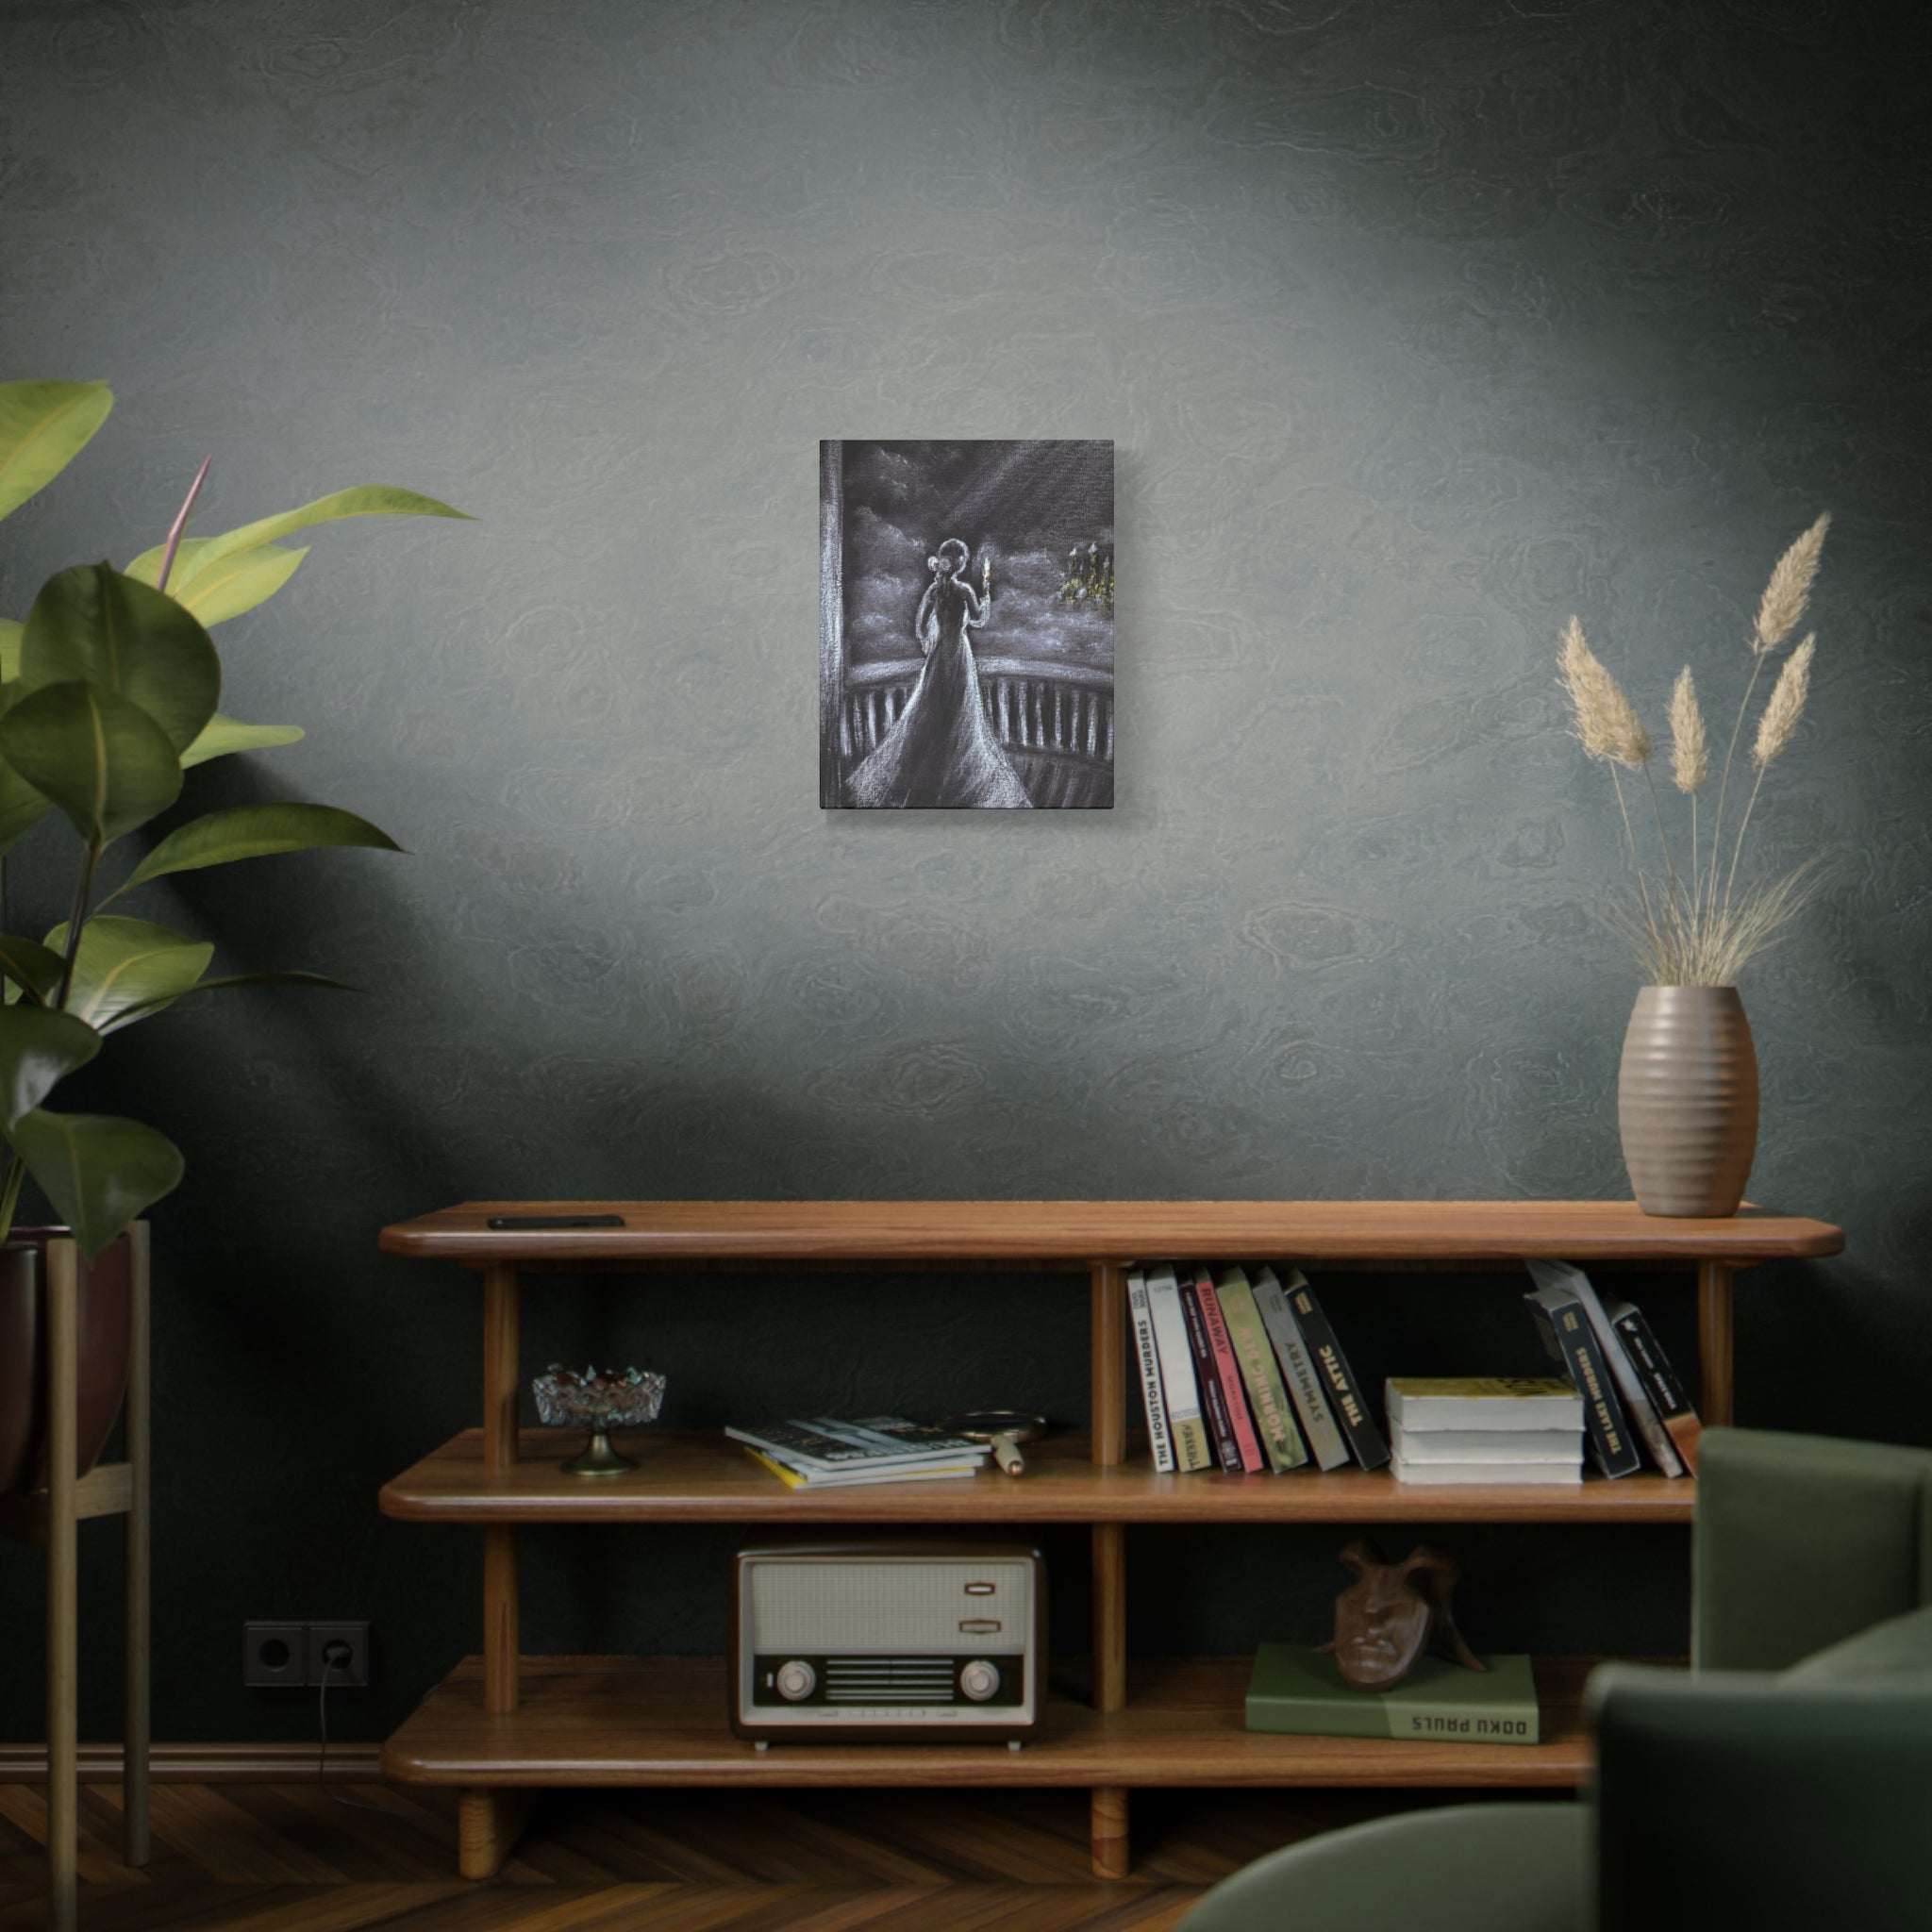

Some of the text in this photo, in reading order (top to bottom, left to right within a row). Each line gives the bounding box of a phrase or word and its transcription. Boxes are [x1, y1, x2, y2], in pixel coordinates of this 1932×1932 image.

[1138, 1319, 1153, 1377] MURDERS
[1201, 1287, 1227, 1355] RUNAWAY
[1238, 1325, 1286, 1441] MORNING DEW
[1285, 1340, 1324, 1423] SYMMETRY
[1318, 1344, 1363, 1426] THE ATTIC
[1574, 1346, 1603, 1401] MURDERS
[1147, 1381, 1163, 1440] HOUSTON
[1155, 1442, 1168, 1466] THE
[1605, 1430, 1622, 1455] THE
[1411, 1715, 1471, 1733] PAULS
